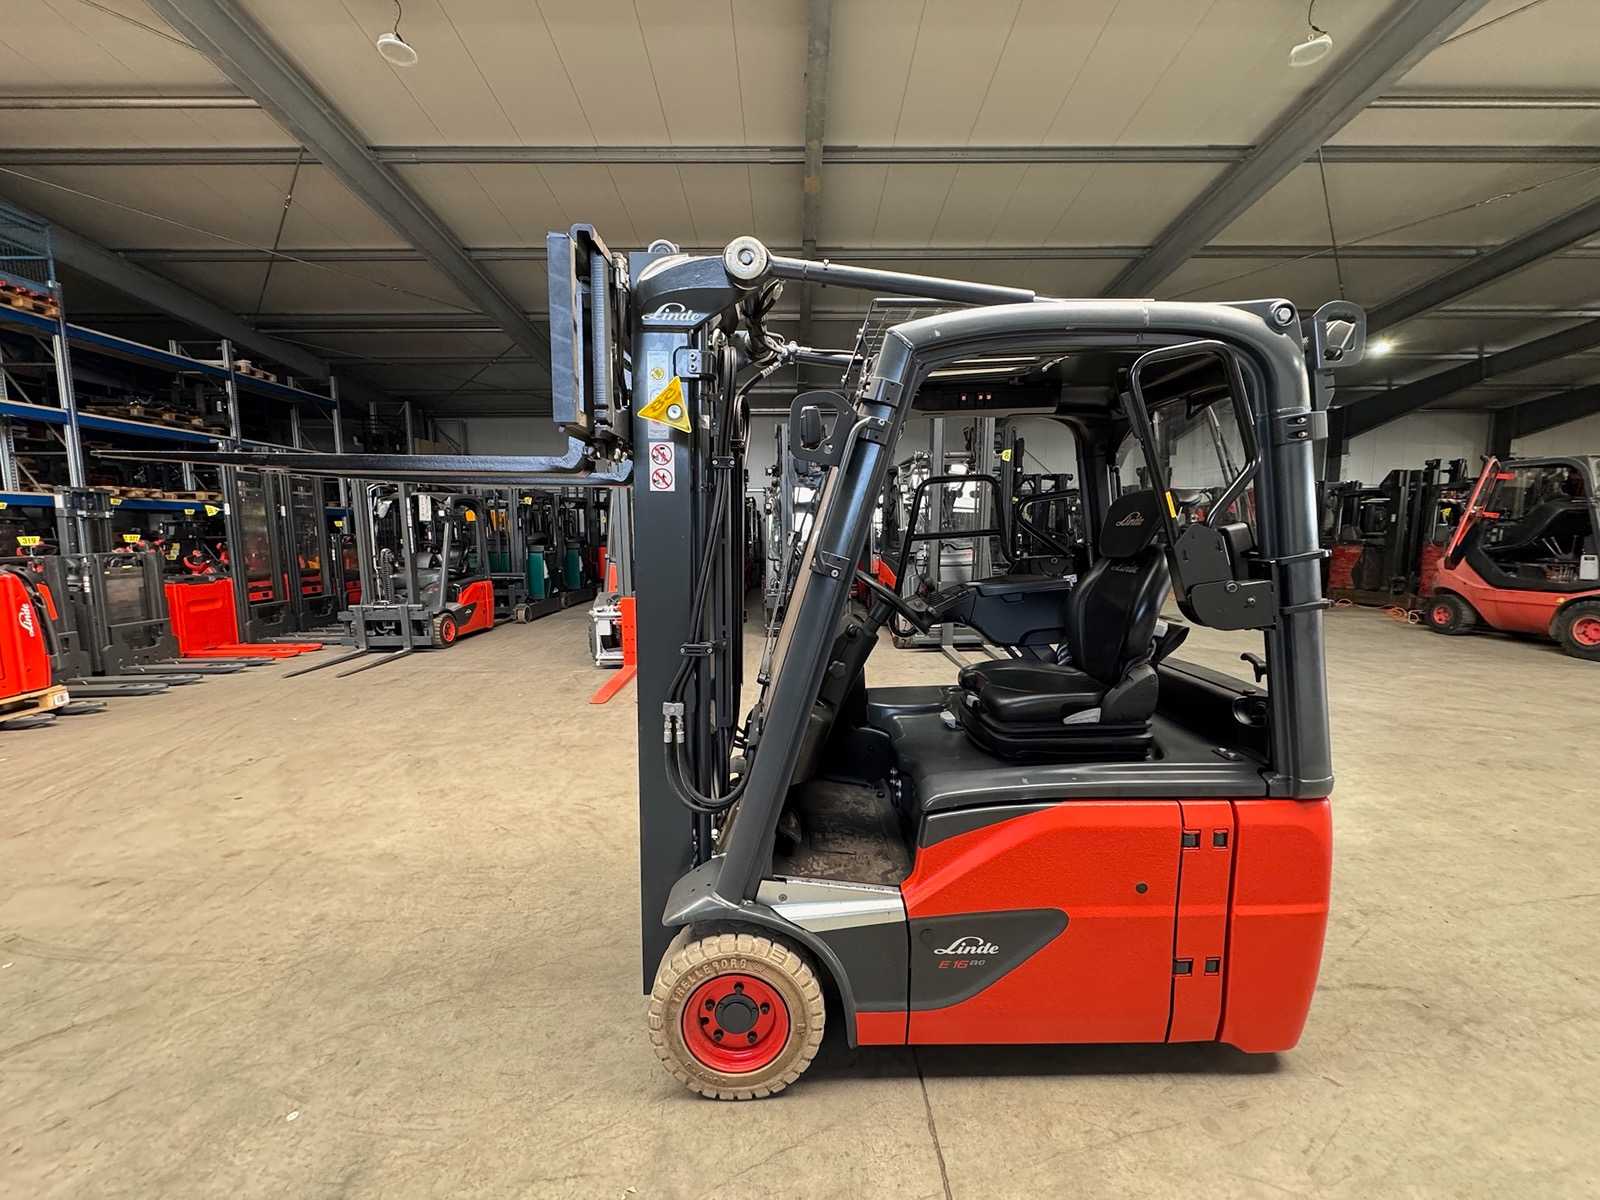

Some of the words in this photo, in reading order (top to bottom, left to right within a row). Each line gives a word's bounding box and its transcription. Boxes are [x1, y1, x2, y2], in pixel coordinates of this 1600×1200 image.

[641, 302, 701, 321] Linde
[1115, 511, 1144, 526] Linde
[18, 603, 35, 637] Linde
[933, 936, 999, 955] Linde
